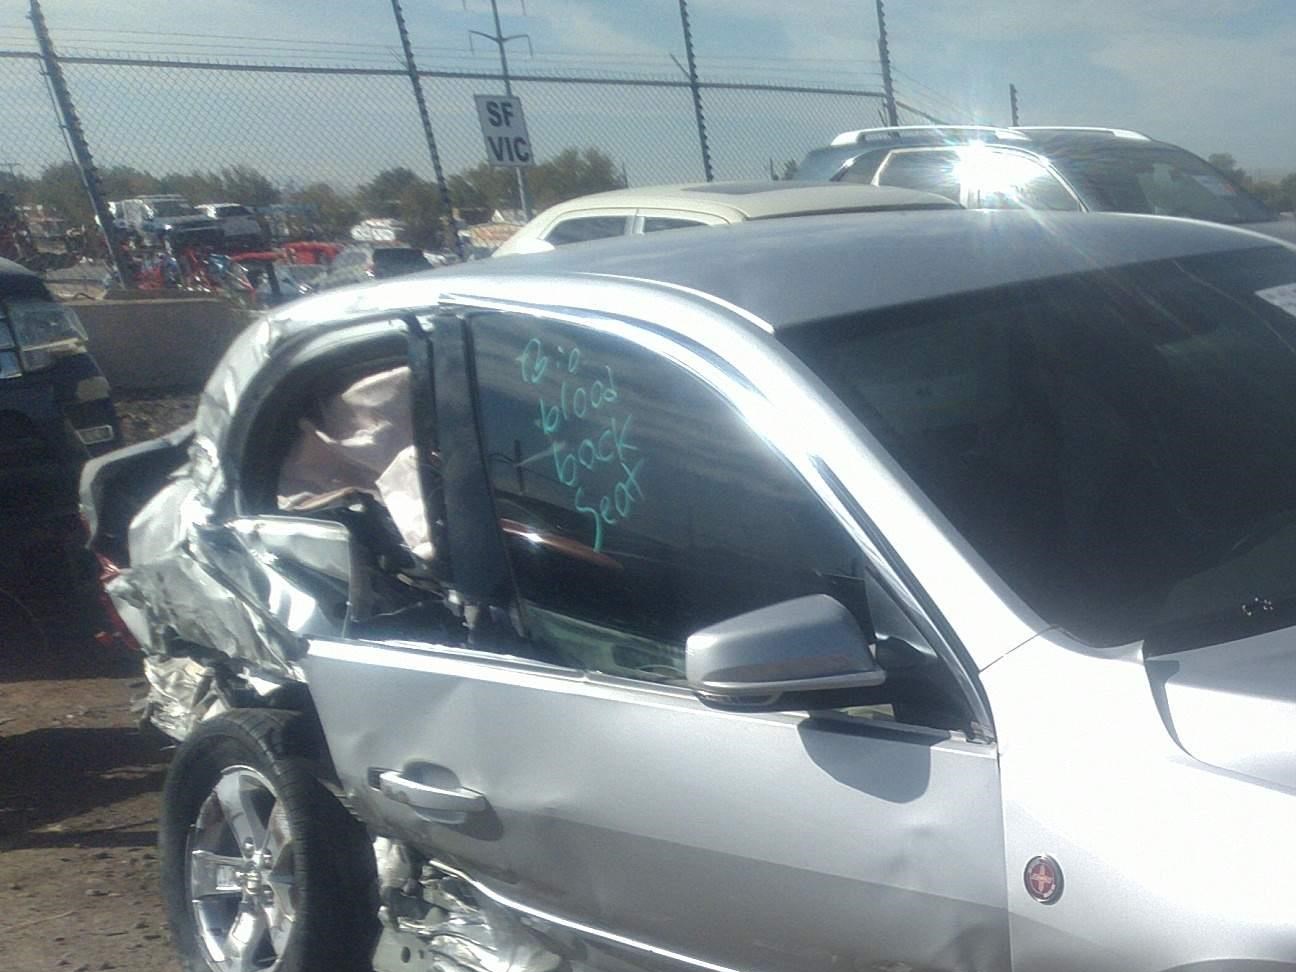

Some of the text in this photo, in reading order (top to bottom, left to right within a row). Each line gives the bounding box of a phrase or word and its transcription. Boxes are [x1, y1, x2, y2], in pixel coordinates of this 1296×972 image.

[486, 101, 514, 127] SF
[488, 136, 529, 162] VIC
[536, 365, 620, 435] blood
